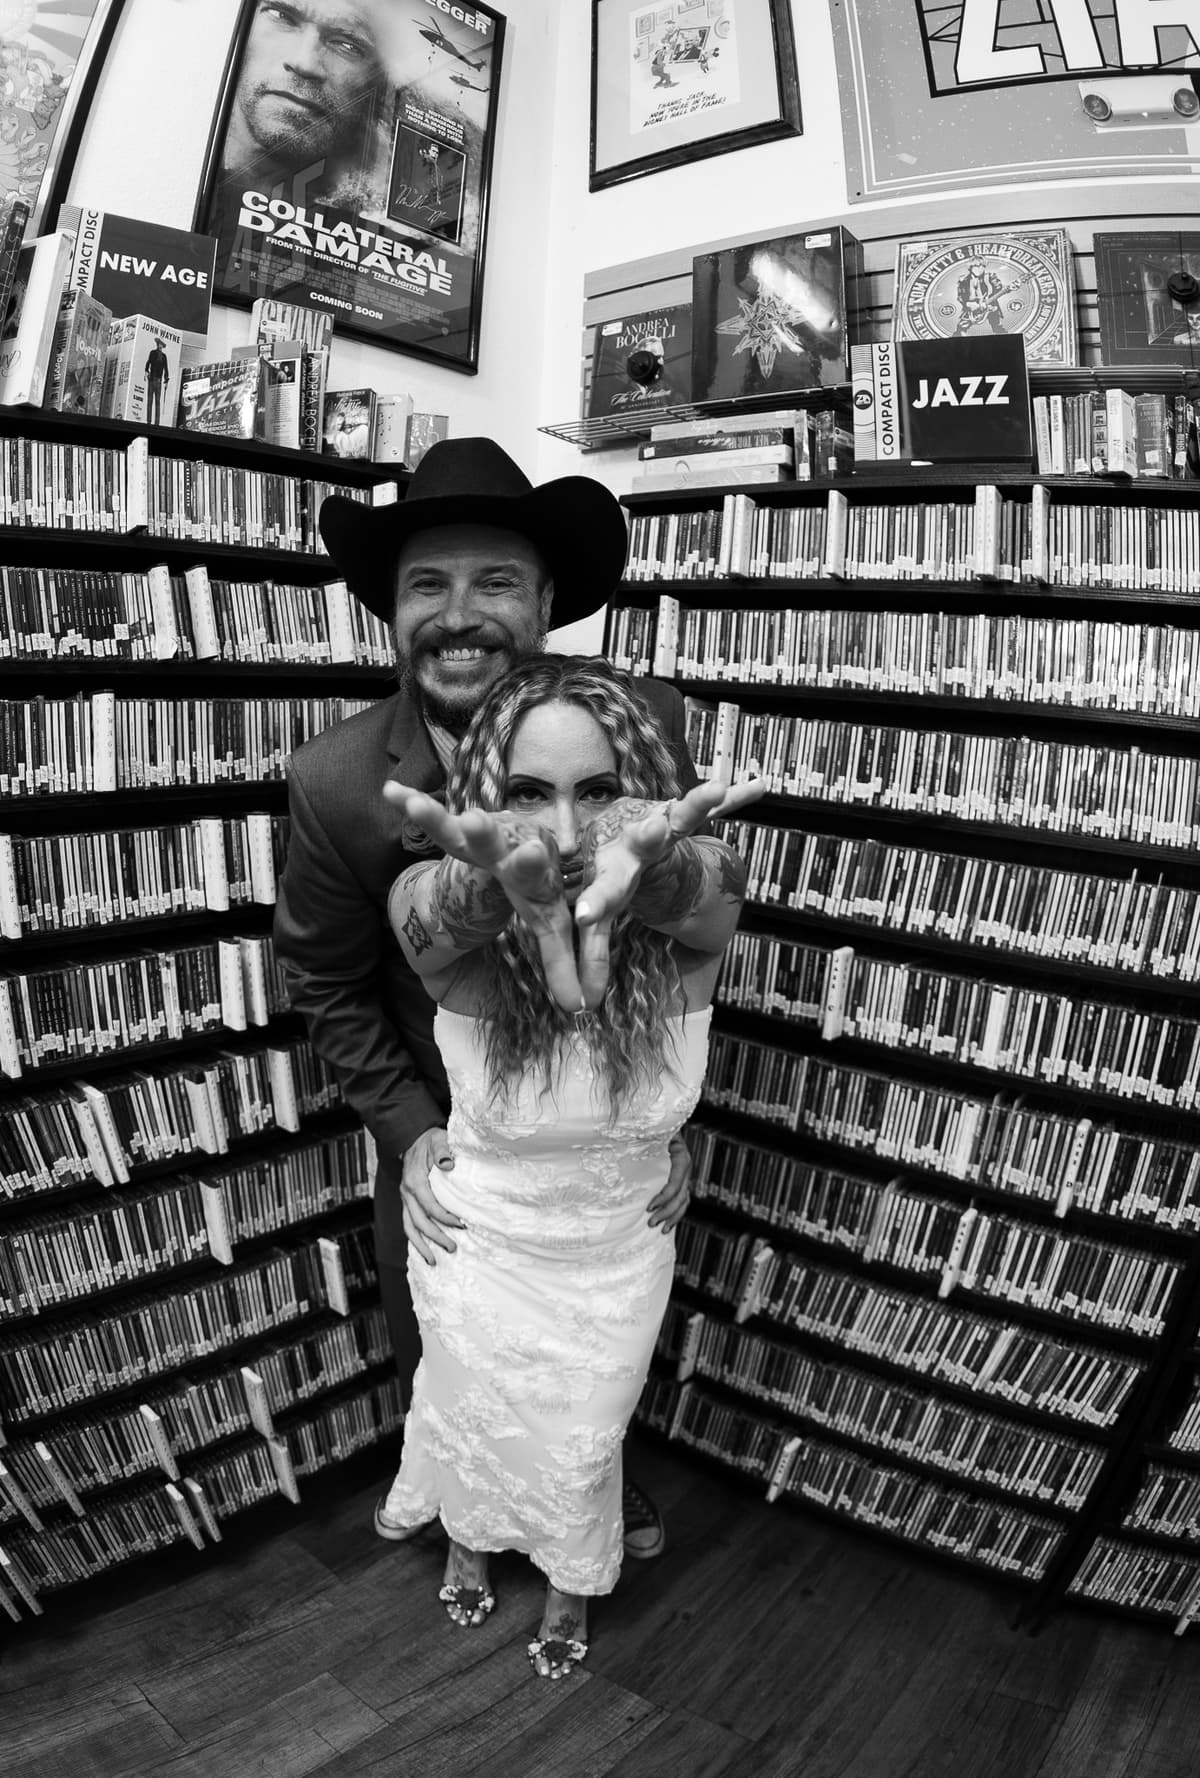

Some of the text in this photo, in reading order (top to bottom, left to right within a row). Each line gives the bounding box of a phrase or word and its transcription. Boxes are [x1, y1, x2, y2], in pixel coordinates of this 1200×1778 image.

[76, 210, 99, 293] MPACT DISC
[238, 207, 452, 296] DAMAGE
[242, 190, 453, 279] COLLATERAL
[100, 251, 208, 290] NEW AGE
[266, 235, 294, 251] FROM
[294, 244, 312, 256] THE
[313, 249, 357, 271] DIRECTOR
[358, 265, 370, 275] OF
[909, 282, 928, 308] TOM
[920, 253, 954, 287] PETTY
[973, 243, 1056, 296] HEARTBREAKERS
[310, 291, 383, 320] COMING SOON
[142, 322, 181, 344] JOHN WAYNE
[622, 317, 669, 336] ANDREA
[878, 344, 894, 456] COMPACT DISC
[912, 374, 1010, 409] JAZZ
